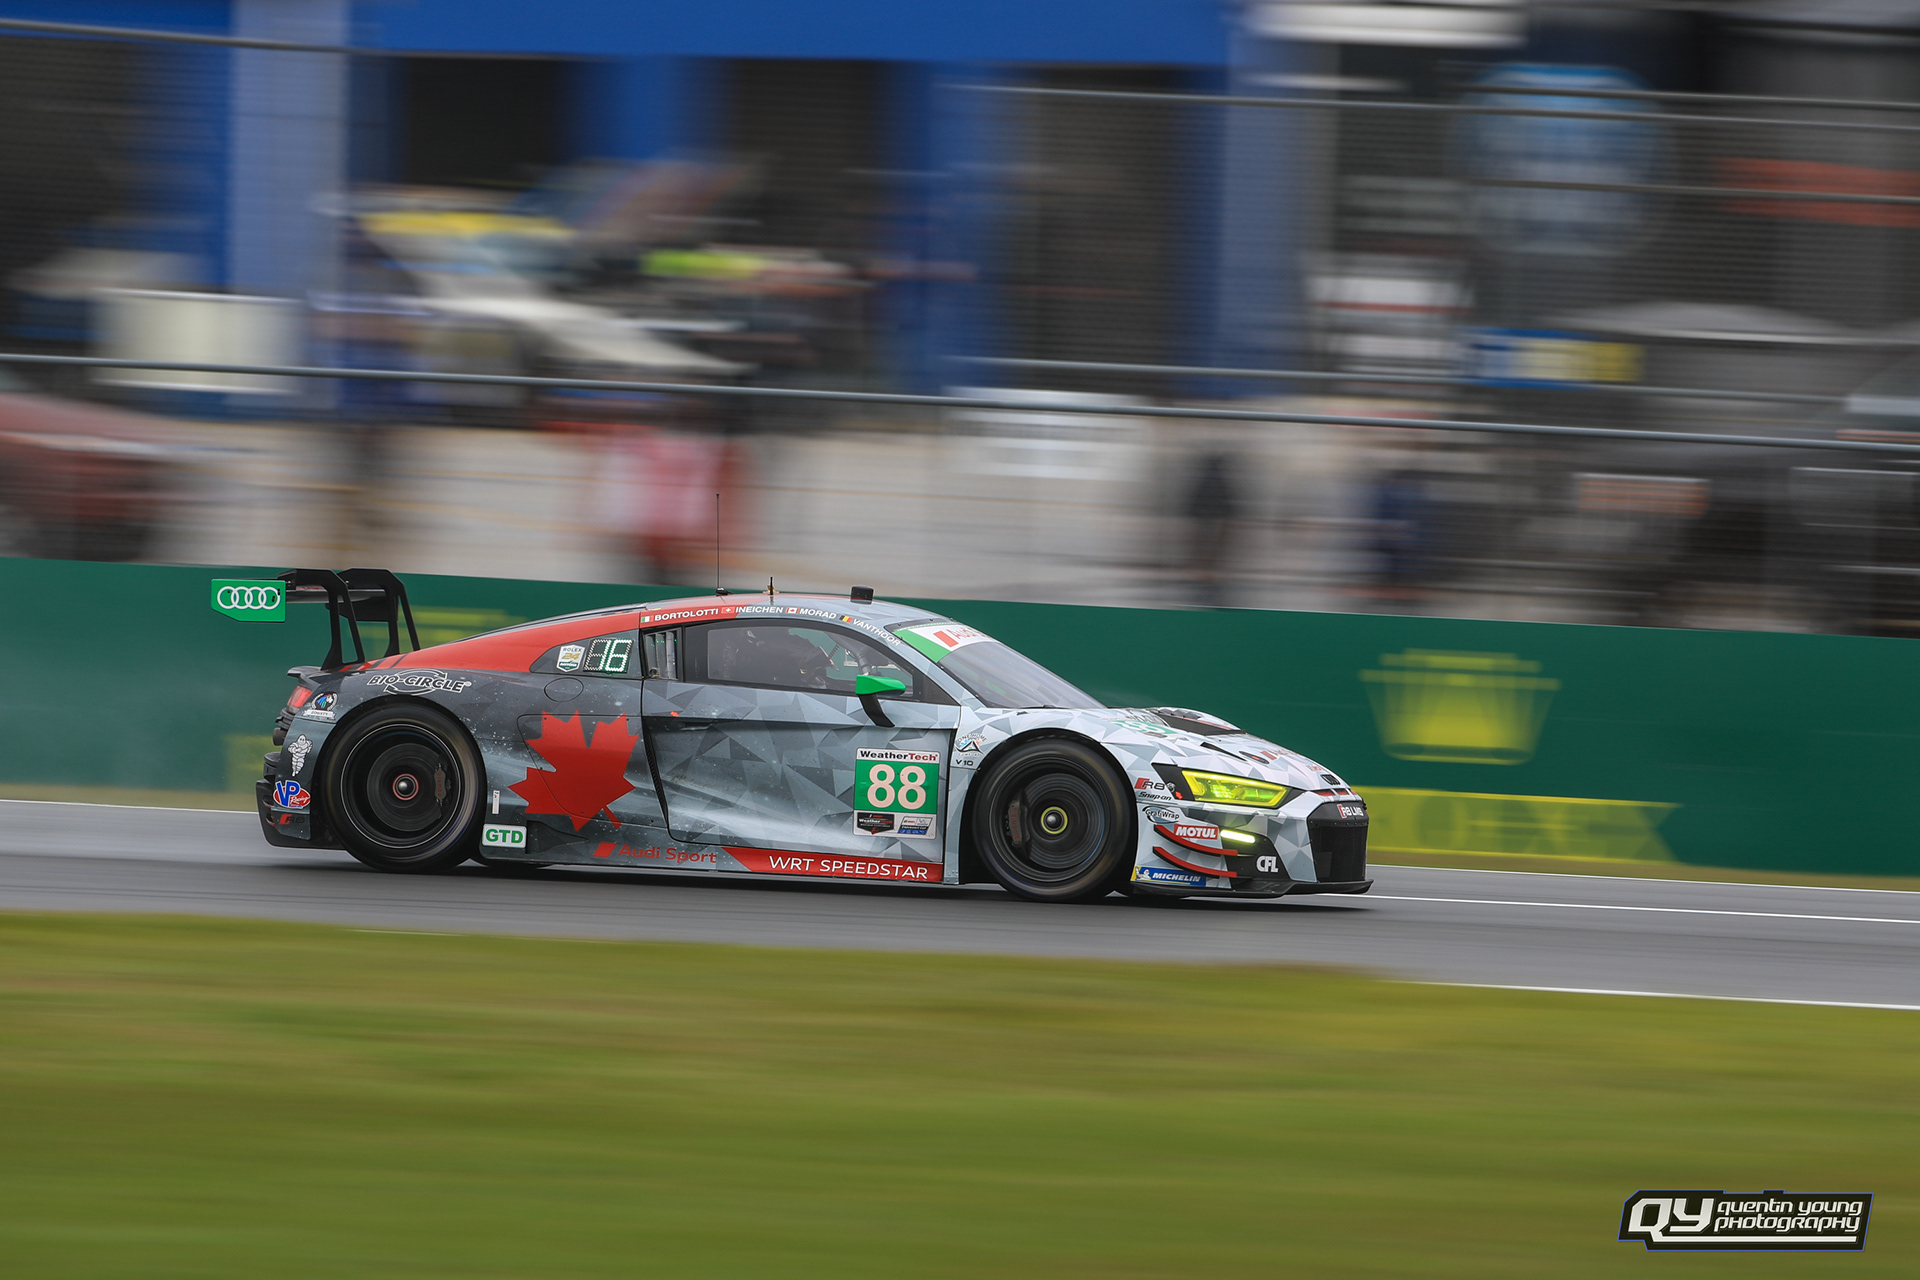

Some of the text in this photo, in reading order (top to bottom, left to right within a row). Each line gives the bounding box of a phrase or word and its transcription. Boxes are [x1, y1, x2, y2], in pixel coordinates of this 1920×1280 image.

[654, 608, 719, 621] BORTOLOTTI
[735, 606, 783, 614] INEICHEN
[799, 608, 837, 619] MORAD
[852, 618, 902, 646] VANTHOOR
[367, 674, 465, 694] BIO-CIRCLE
[860, 751, 937, 761] WeatherTech
[867, 764, 927, 810] 88
[1141, 780, 1166, 790] R8
[275, 780, 301, 807] VP
[485, 828, 523, 844] GTD
[1175, 826, 1216, 838] MOTUL
[618, 844, 717, 863] Audi Sport
[769, 856, 928, 879] WRT SPEEDSTAR
[1256, 856, 1278, 873] CFL
[1152, 872, 1201, 883] MICHELIN
